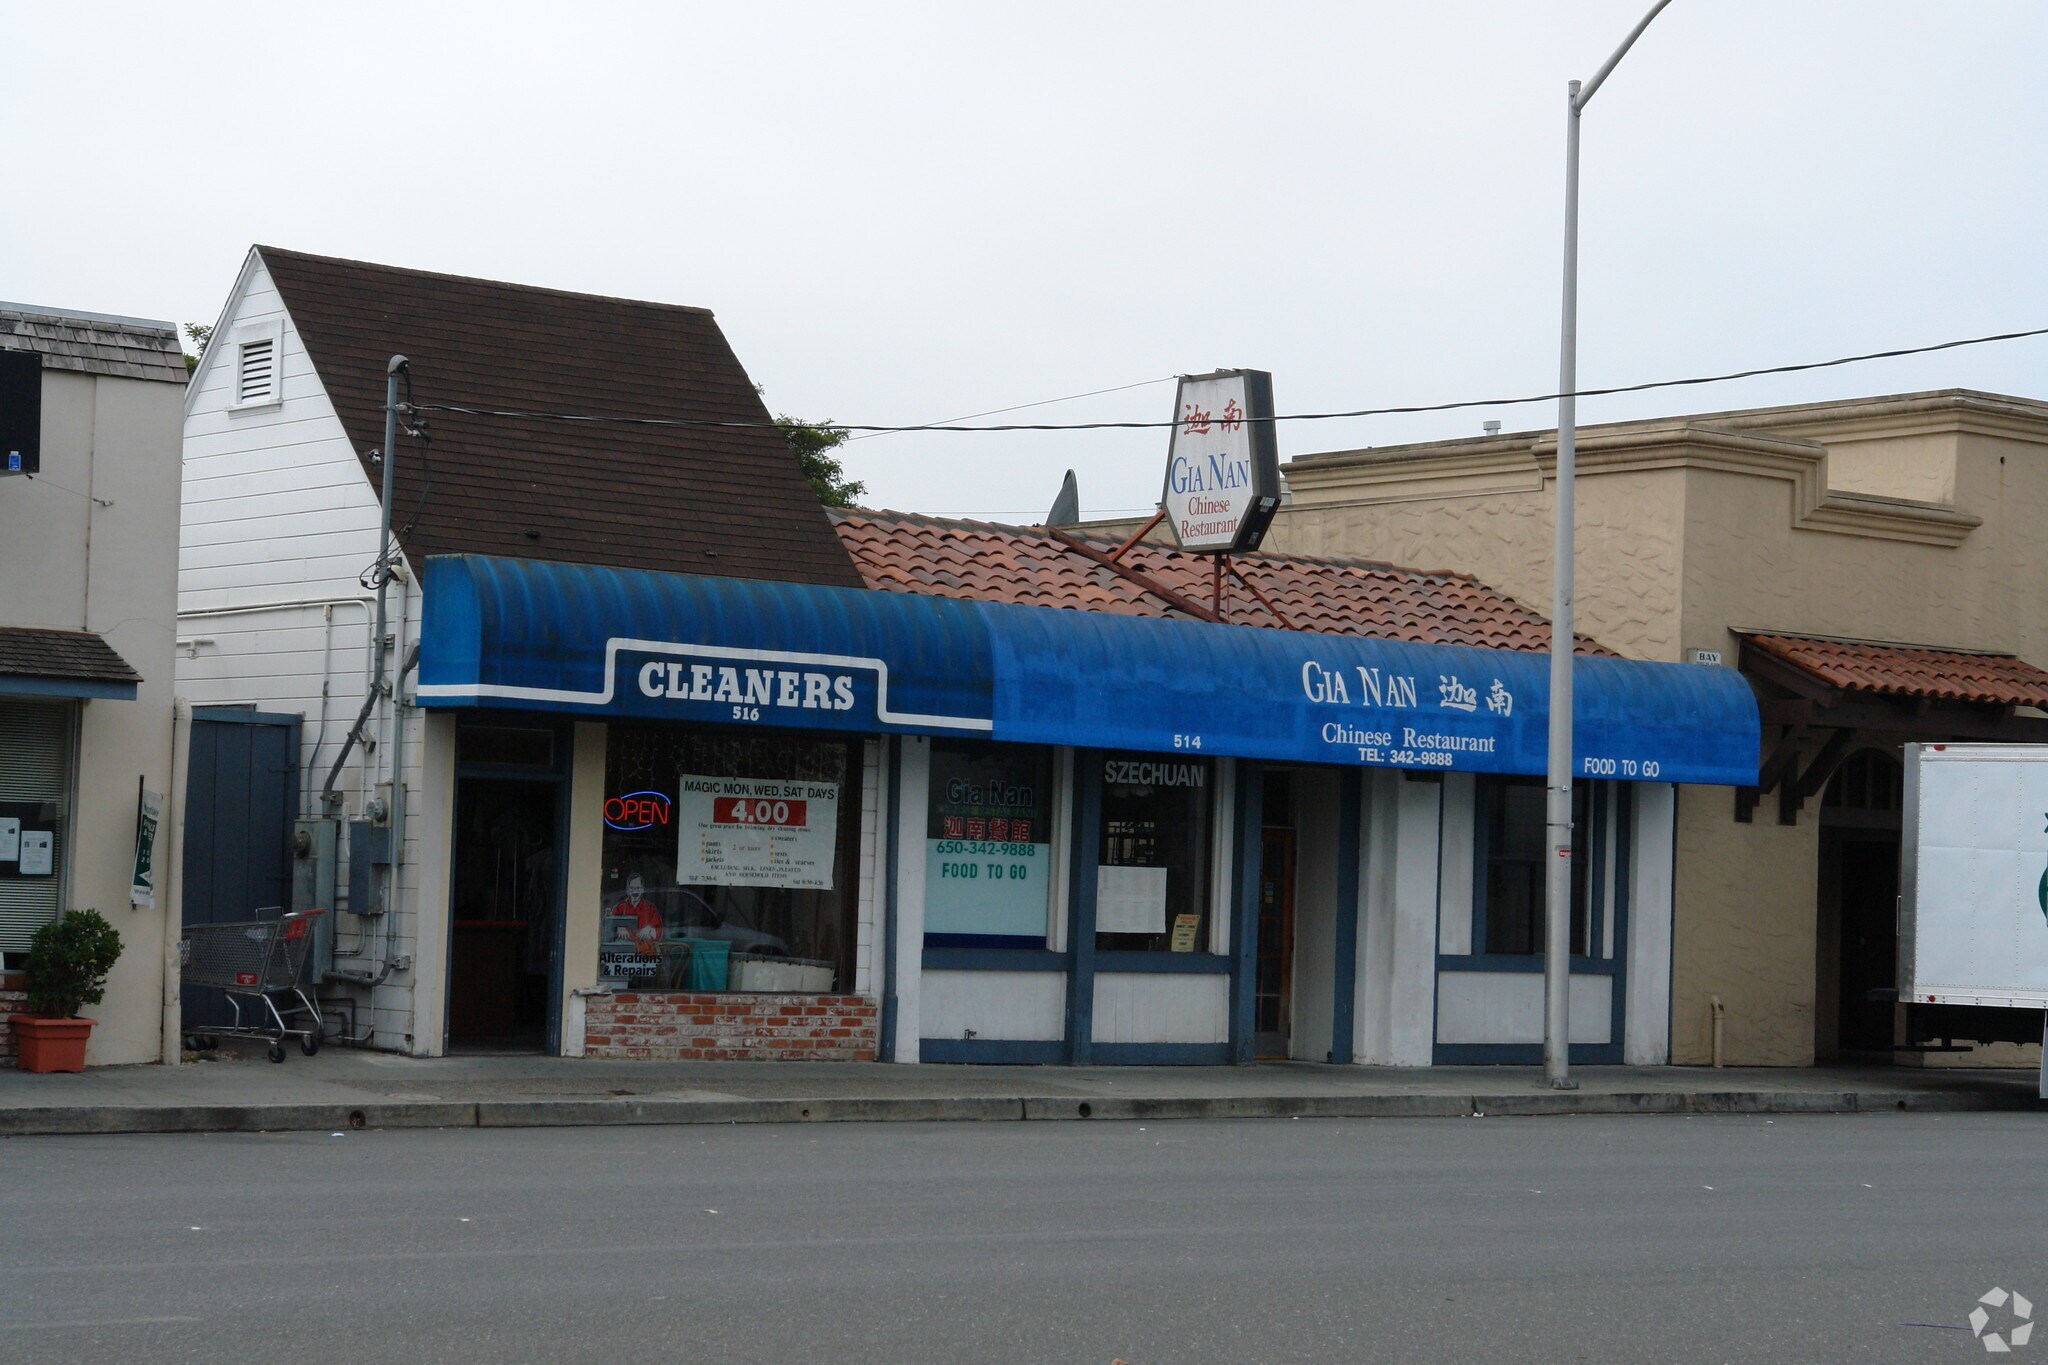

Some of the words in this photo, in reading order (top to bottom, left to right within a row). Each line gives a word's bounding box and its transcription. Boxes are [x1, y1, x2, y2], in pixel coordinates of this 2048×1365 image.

[1188, 496, 1230, 516] Chinese
[1180, 516, 1238, 539] Restaurant
[1699, 652, 1718, 661] BAY
[638, 662, 855, 710] CLEANERS
[732, 706, 760, 722] 516
[1174, 734, 1202, 749] 514
[1322, 722, 1392, 747] Chinese
[1402, 728, 1496, 752] Restaurant
[1358, 748, 1385, 762] TEL:
[1390, 750, 1453, 766] 342-9888
[1104, 760, 1204, 788] SZECHUAN
[1584, 757, 1616, 775] FOOD
[1622, 760, 1637, 776] TO
[1642, 761, 1660, 778] GO
[684, 781, 720, 793] MAGIC
[784, 786, 803, 797] SAT
[808, 787, 835, 800] DAYS
[946, 776, 982, 805] Gia
[990, 779, 1032, 807] Nan
[604, 798, 668, 825] OPEN
[731, 800, 789, 824] 4.00
[936, 841, 1036, 856] 650-342-9888
[704, 856, 724, 864] jackets
[942, 862, 978, 878] FOOD
[987, 864, 1002, 880] TO
[1010, 864, 1027, 880] GO
[600, 951, 663, 964] Alterations
[604, 966, 612, 976] &
[614, 964, 656, 979] Repairs
